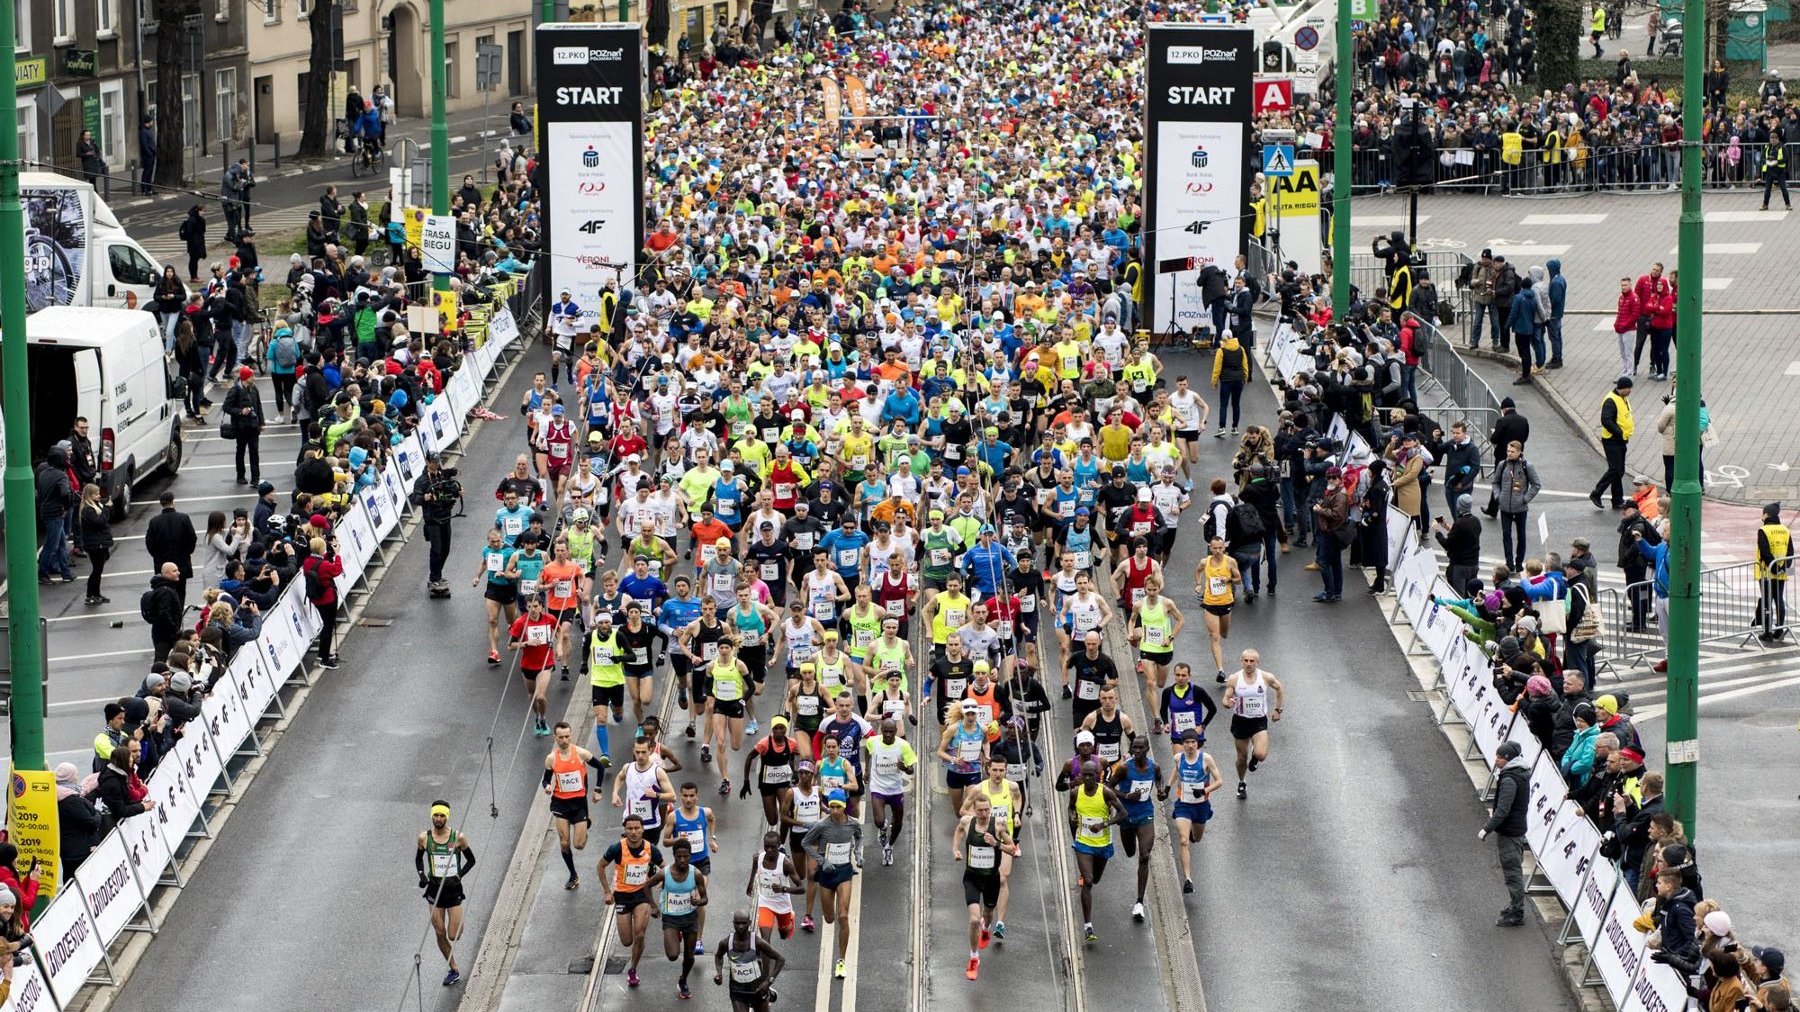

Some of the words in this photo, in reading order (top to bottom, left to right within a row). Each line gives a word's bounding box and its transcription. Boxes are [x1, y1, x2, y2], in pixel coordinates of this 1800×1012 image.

[556, 87, 623, 105] START
[1168, 86, 1236, 105] START
[1262, 84, 1286, 107] A
[1272, 171, 1318, 194] AA
[425, 229, 450, 240] TRASA
[579, 220, 606, 234] 4F
[1184, 221, 1212, 234] 4F
[424, 240, 451, 250] BIEGU
[45, 911, 90, 979] BRIDGESTONE
[1605, 910, 1638, 978] BRIDGESTONE
